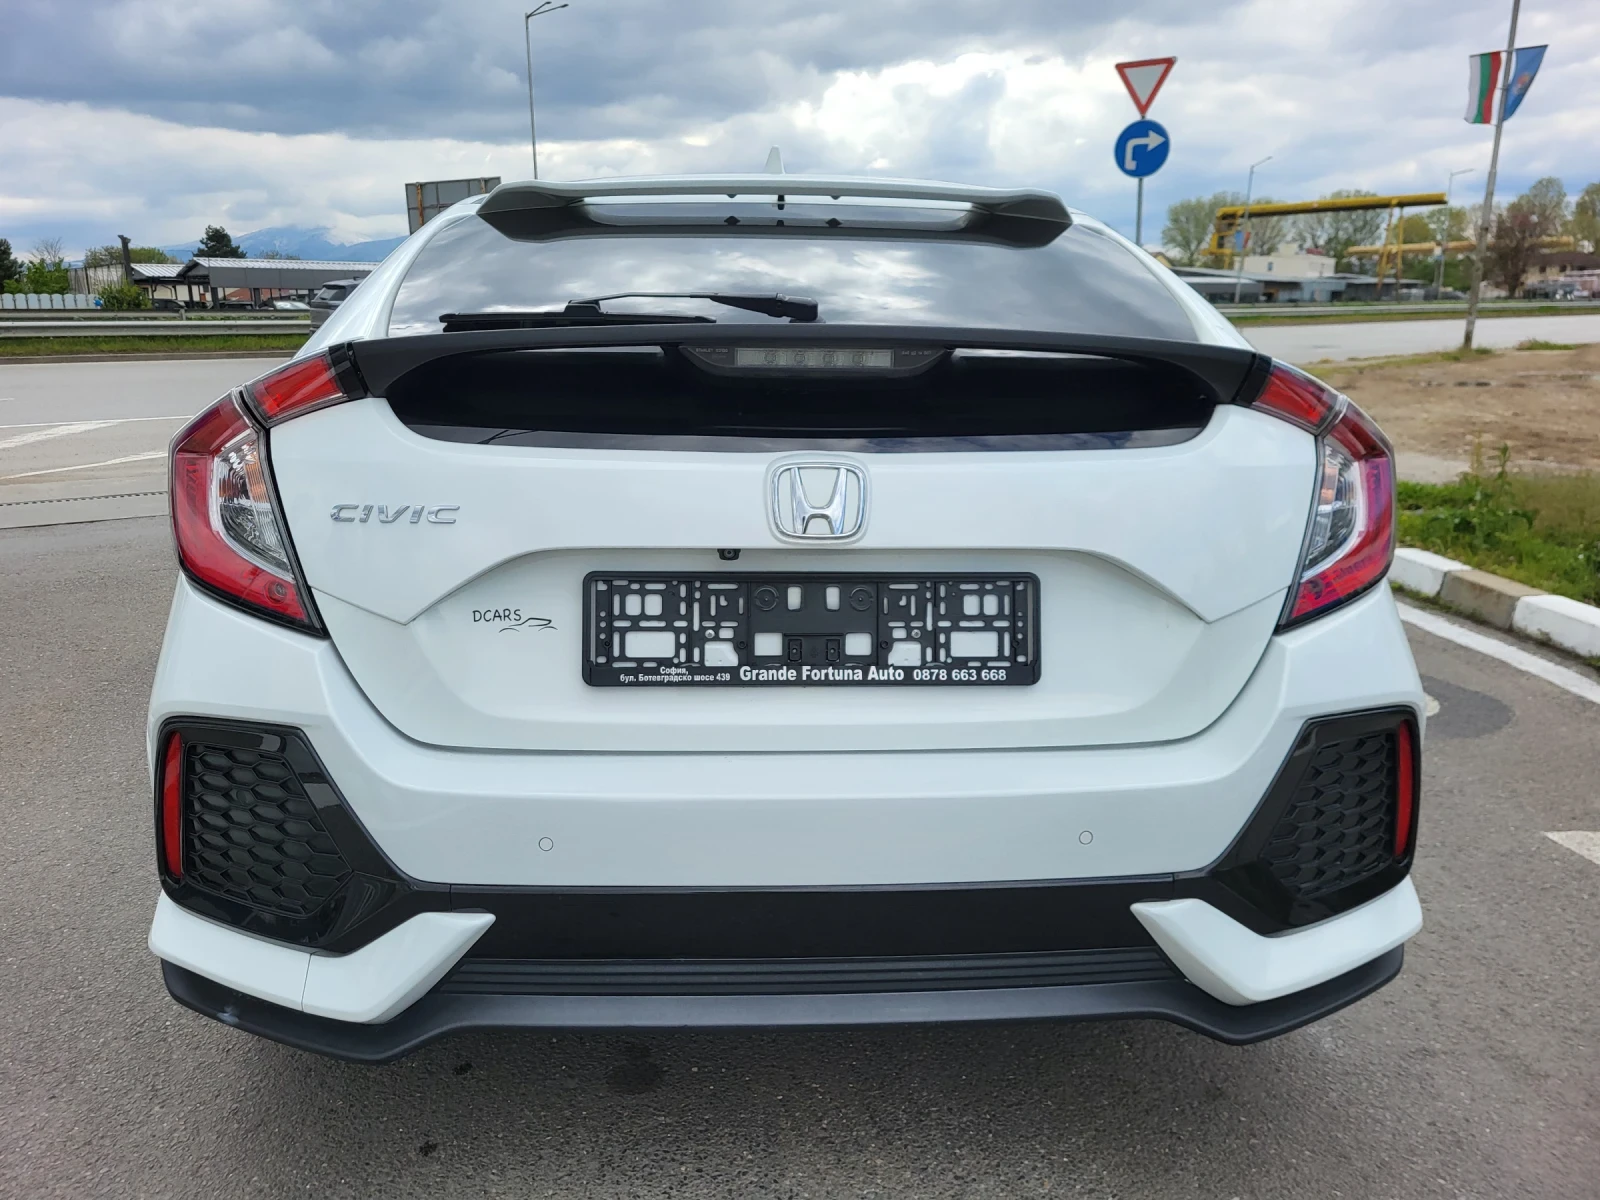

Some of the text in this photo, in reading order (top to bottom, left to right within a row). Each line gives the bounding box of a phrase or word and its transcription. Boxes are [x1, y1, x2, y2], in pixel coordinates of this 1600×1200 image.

[330, 504, 460, 524] CIVIC
[472, 608, 522, 623] DCARS
[620, 674, 636, 683] бул.
[716, 673, 731, 681] 439
[660, 666, 689, 675] София,
[739, 665, 1007, 681] Grande Fortuna Auto 0878 663 668
